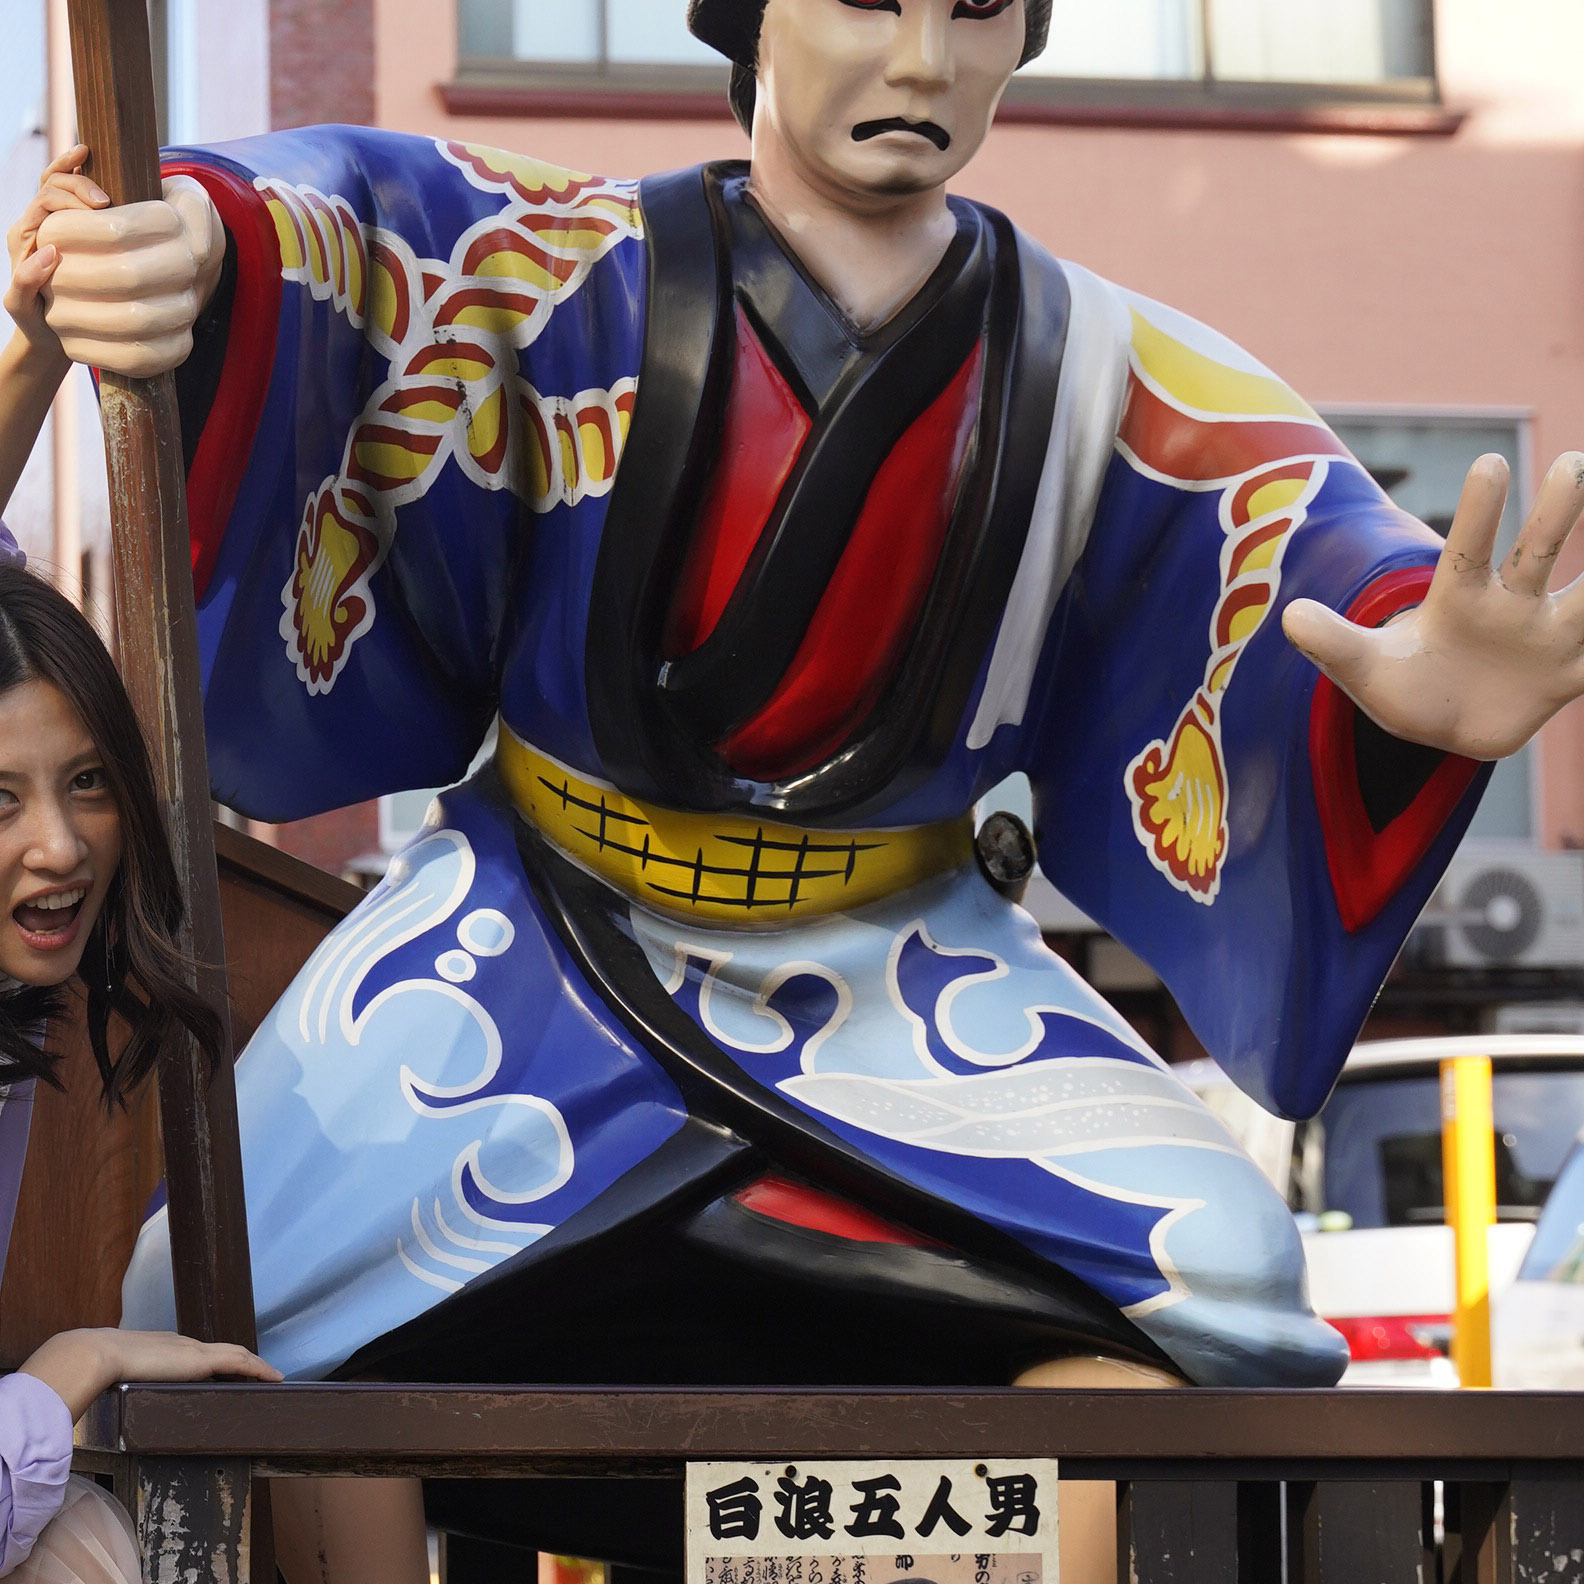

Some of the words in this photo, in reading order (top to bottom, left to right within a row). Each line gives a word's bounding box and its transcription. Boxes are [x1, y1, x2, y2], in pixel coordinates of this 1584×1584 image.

[706, 1473, 1040, 1540] 白浪五人男
